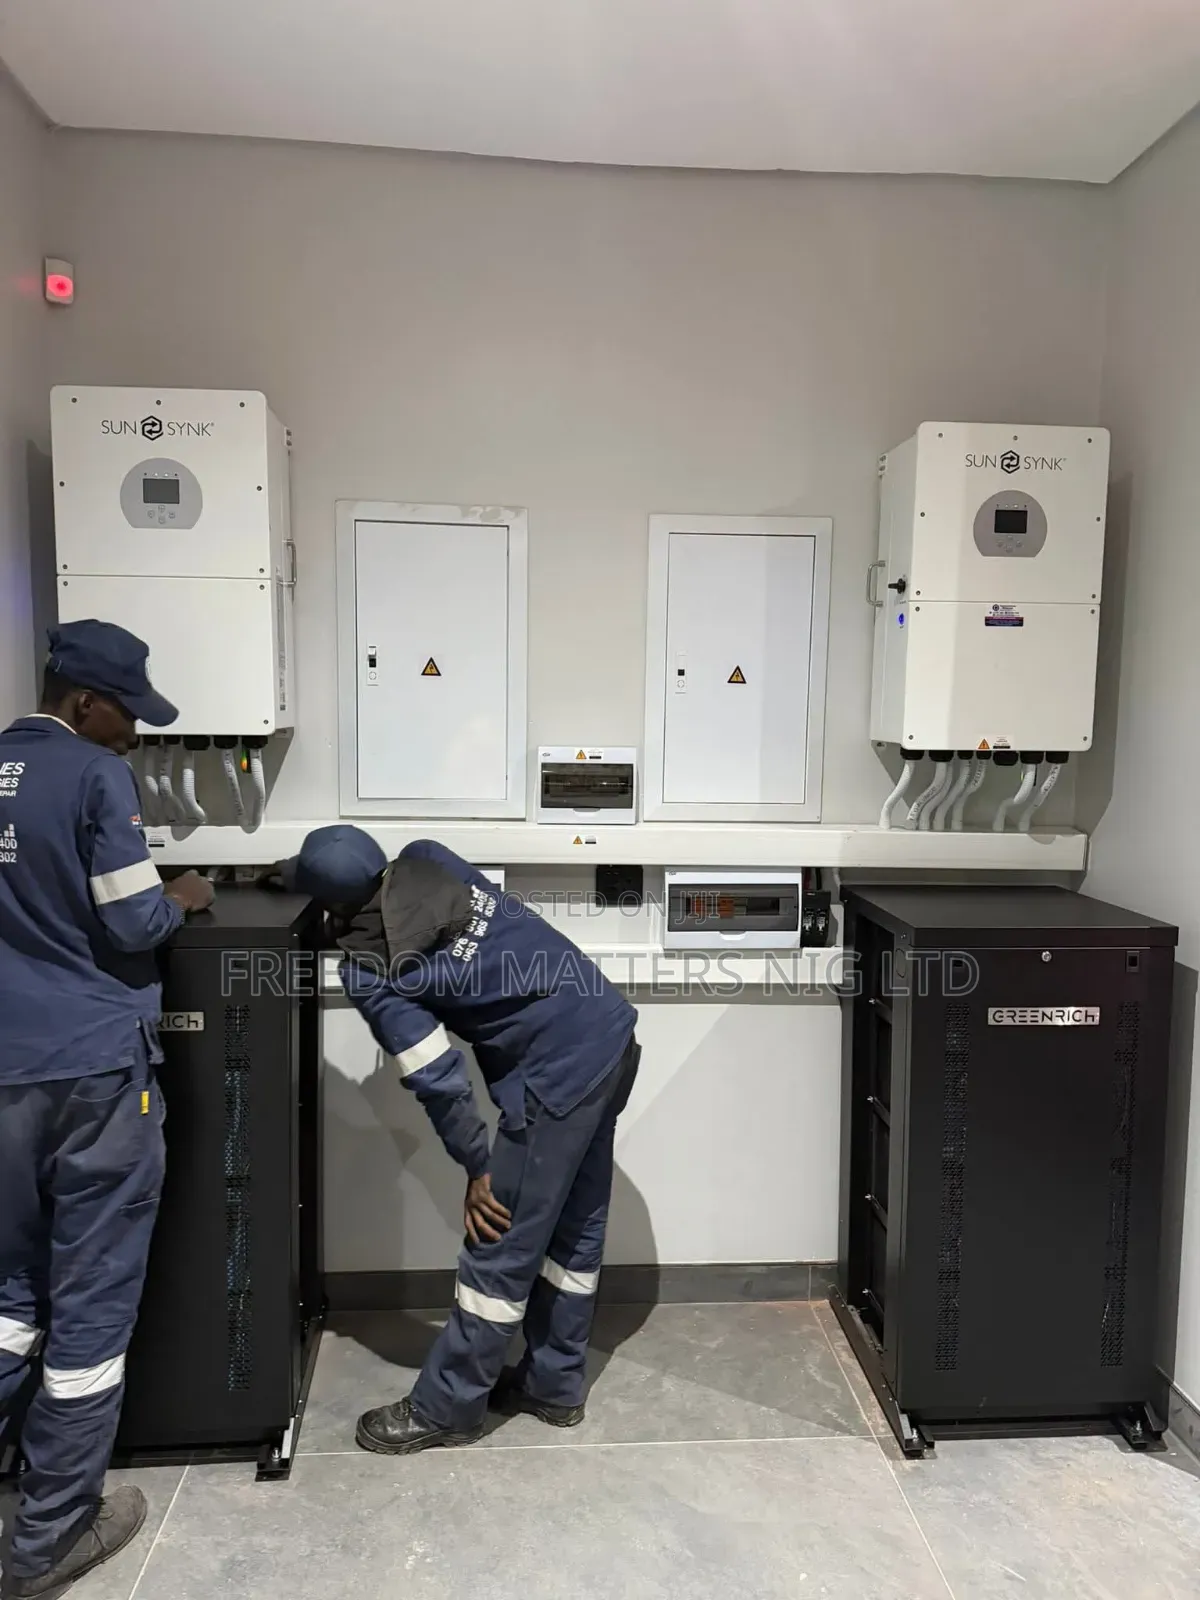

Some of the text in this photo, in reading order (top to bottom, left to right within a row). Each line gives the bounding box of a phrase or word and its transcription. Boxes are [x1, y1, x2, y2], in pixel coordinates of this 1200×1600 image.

[101, 420, 137, 435] SUN
[965, 453, 997, 469] SUN
[452, 938, 469, 957] 076
[462, 941, 479, 962] 063
